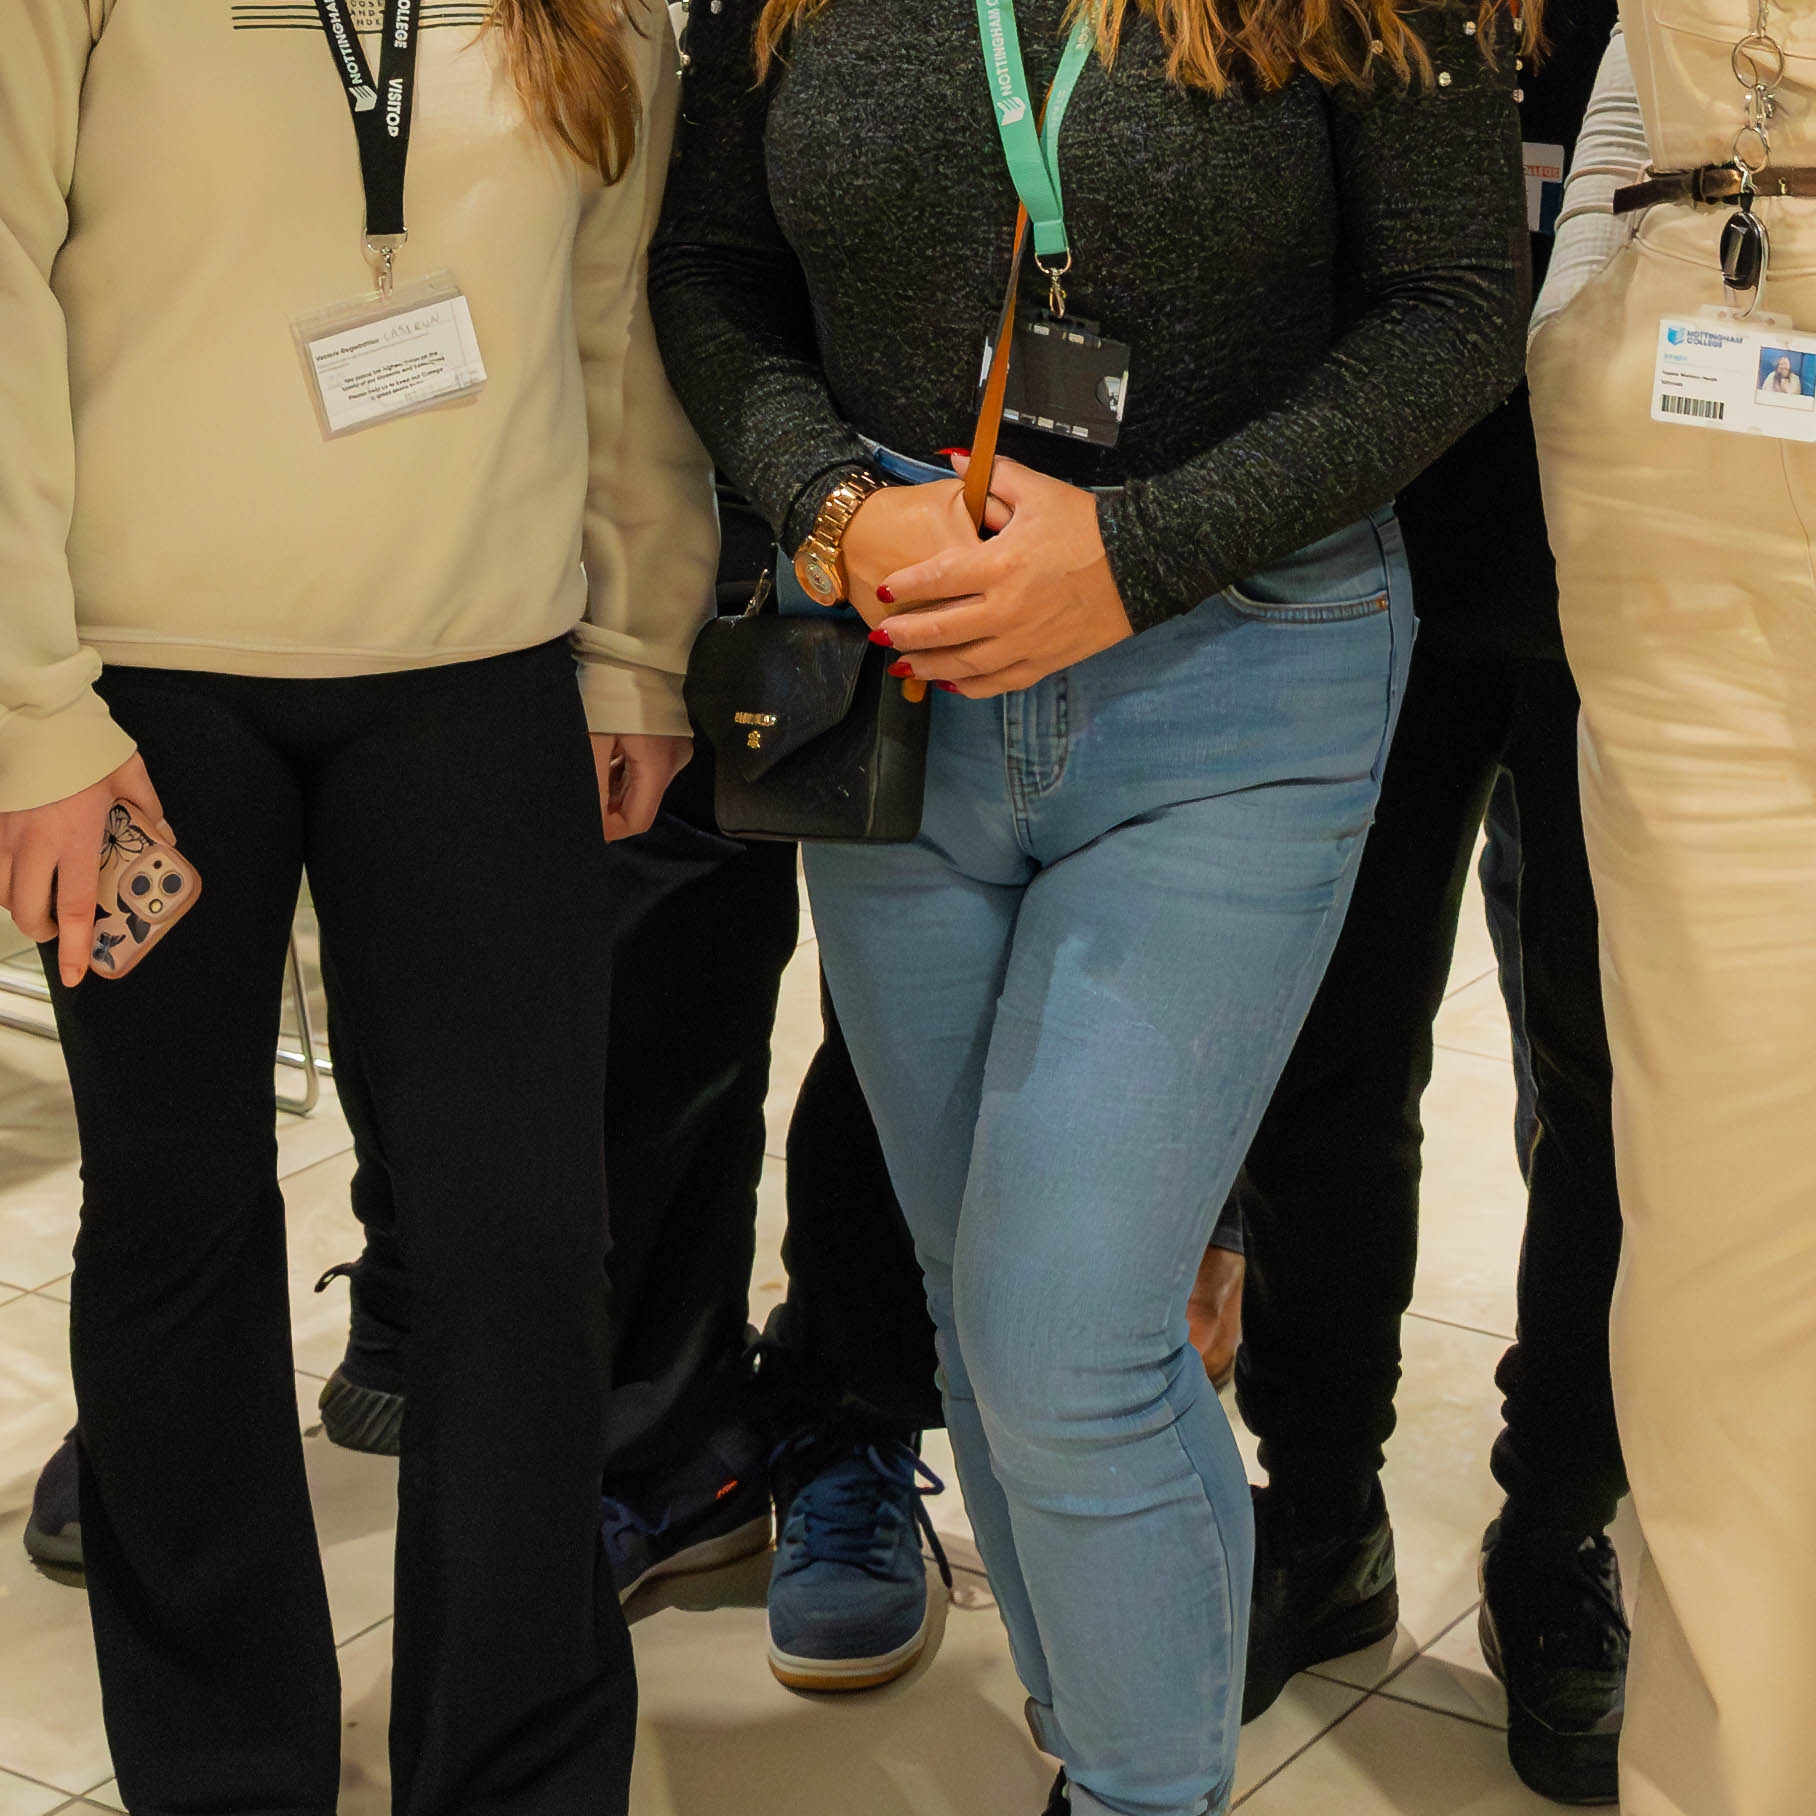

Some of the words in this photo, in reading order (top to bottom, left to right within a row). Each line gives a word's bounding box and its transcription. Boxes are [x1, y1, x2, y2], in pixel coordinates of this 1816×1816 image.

[985, 7, 1013, 97] NOTTINGHAM
[1686, 337, 1723, 348] COLLEGE
[1687, 330, 1744, 344] NOTTINGHAM
